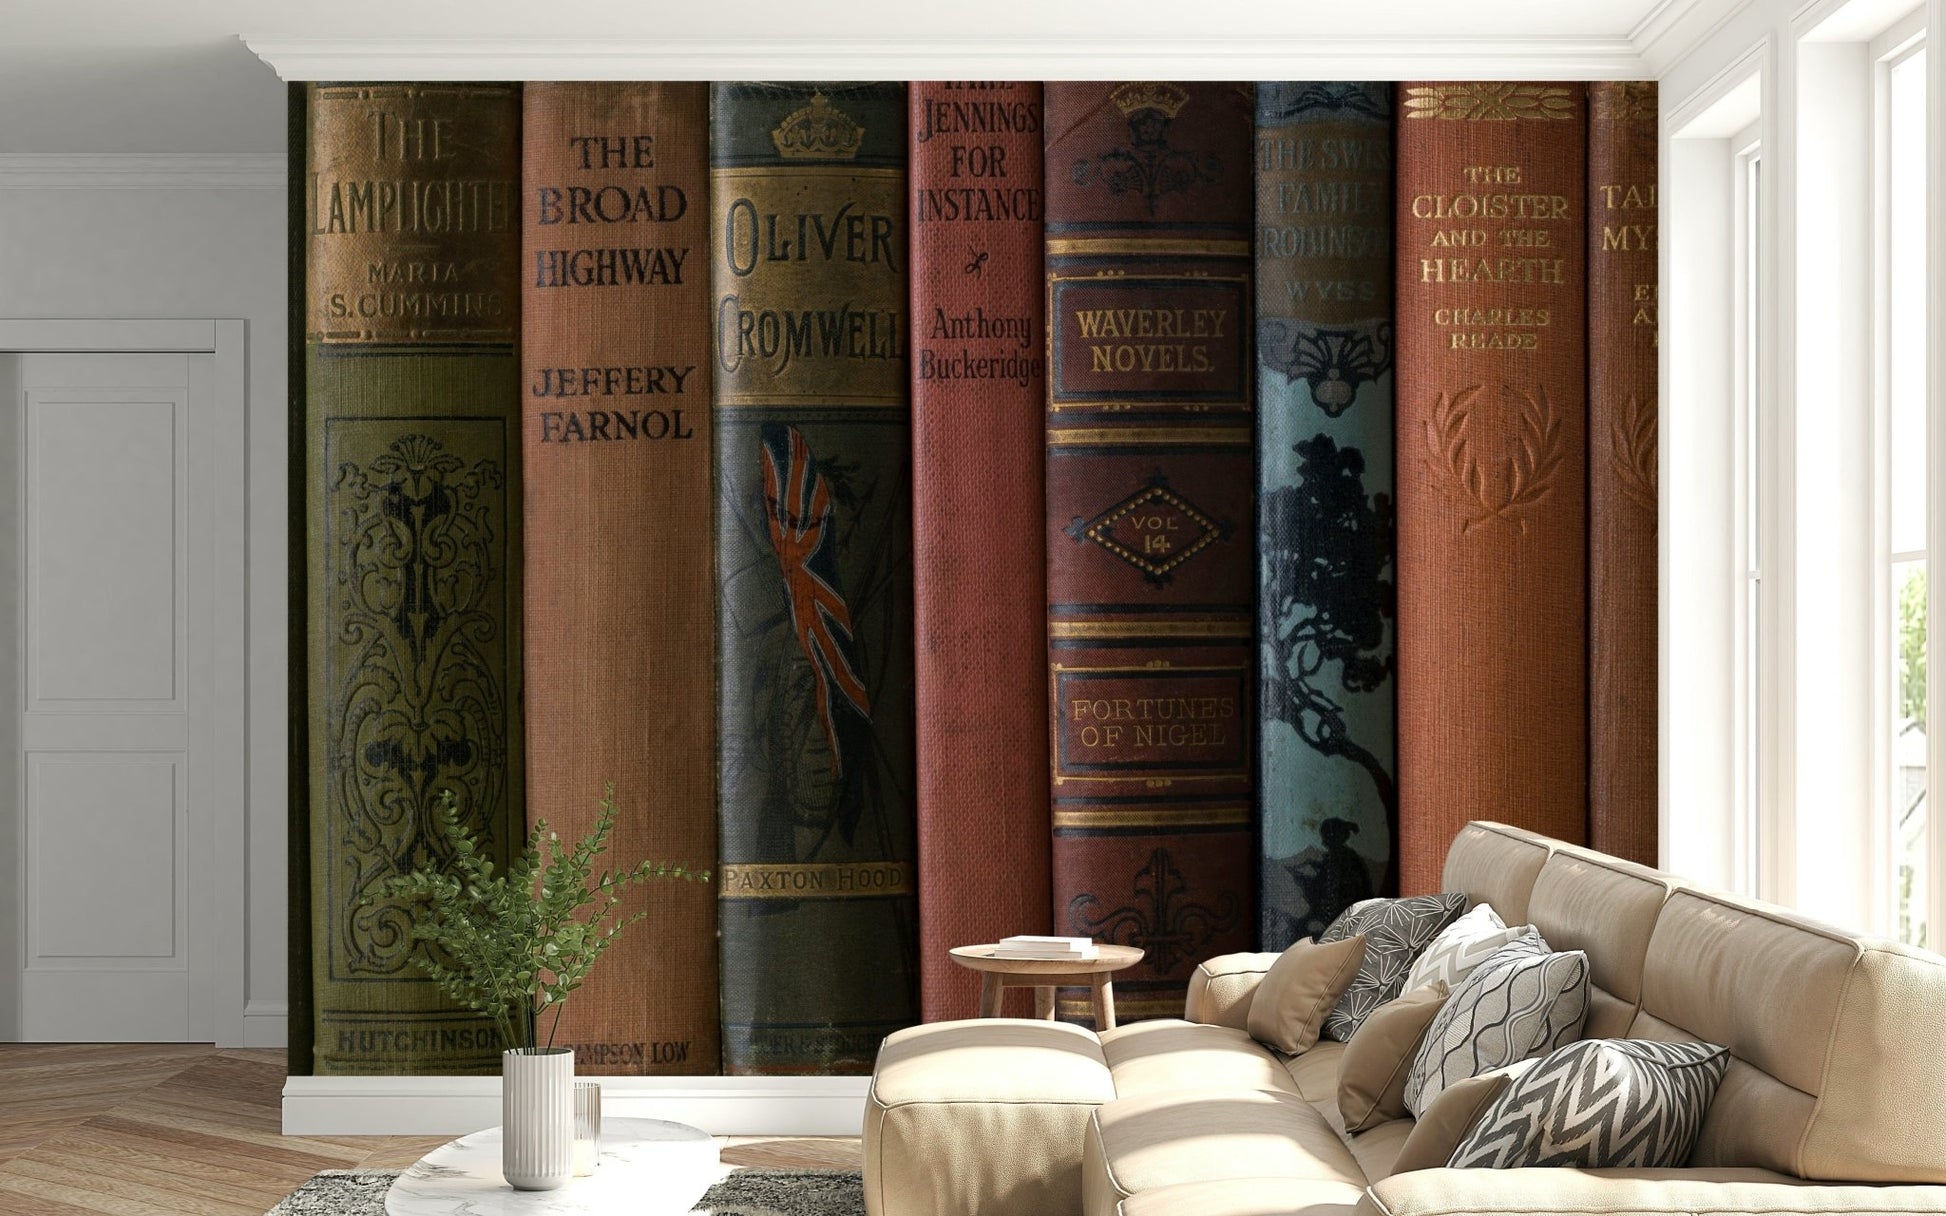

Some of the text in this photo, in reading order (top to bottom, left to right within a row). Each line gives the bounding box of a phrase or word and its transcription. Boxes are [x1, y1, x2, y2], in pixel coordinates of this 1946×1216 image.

[367, 111, 456, 160] THE
[918, 99, 1039, 144] JENNINGS
[571, 135, 654, 169] THE
[950, 146, 1007, 178] FOR
[1463, 166, 1521, 184] THE
[538, 186, 688, 225] BROAD
[917, 189, 1040, 223] INSTANCE
[1411, 194, 1571, 220] CLOISTER
[726, 198, 901, 276] OLIVER
[1430, 229, 1551, 248] AND THE
[368, 262, 459, 284] MARIA
[536, 248, 692, 288] HIGHWAY
[1420, 258, 1565, 284] HEARTH
[931, 308, 1031, 349] Anthony
[1076, 309, 1227, 339] WAVERLEY
[1434, 309, 1551, 326] CHARLES
[718, 294, 907, 376] CROMWELL
[1450, 333, 1538, 350] READE
[919, 349, 1041, 387] Buckeridge
[1091, 345, 1214, 373] NOVELS.
[532, 366, 696, 398] JEFFERY
[540, 410, 693, 444] FARNOL
[1131, 516, 1179, 530] VOL
[1144, 535, 1171, 554] 14
[1071, 697, 1235, 721] FORTUNES
[1080, 724, 1226, 747] OF NIGEL
[724, 868, 901, 891] PAXTON HOOD
[650, 1041, 692, 1064] LOW
